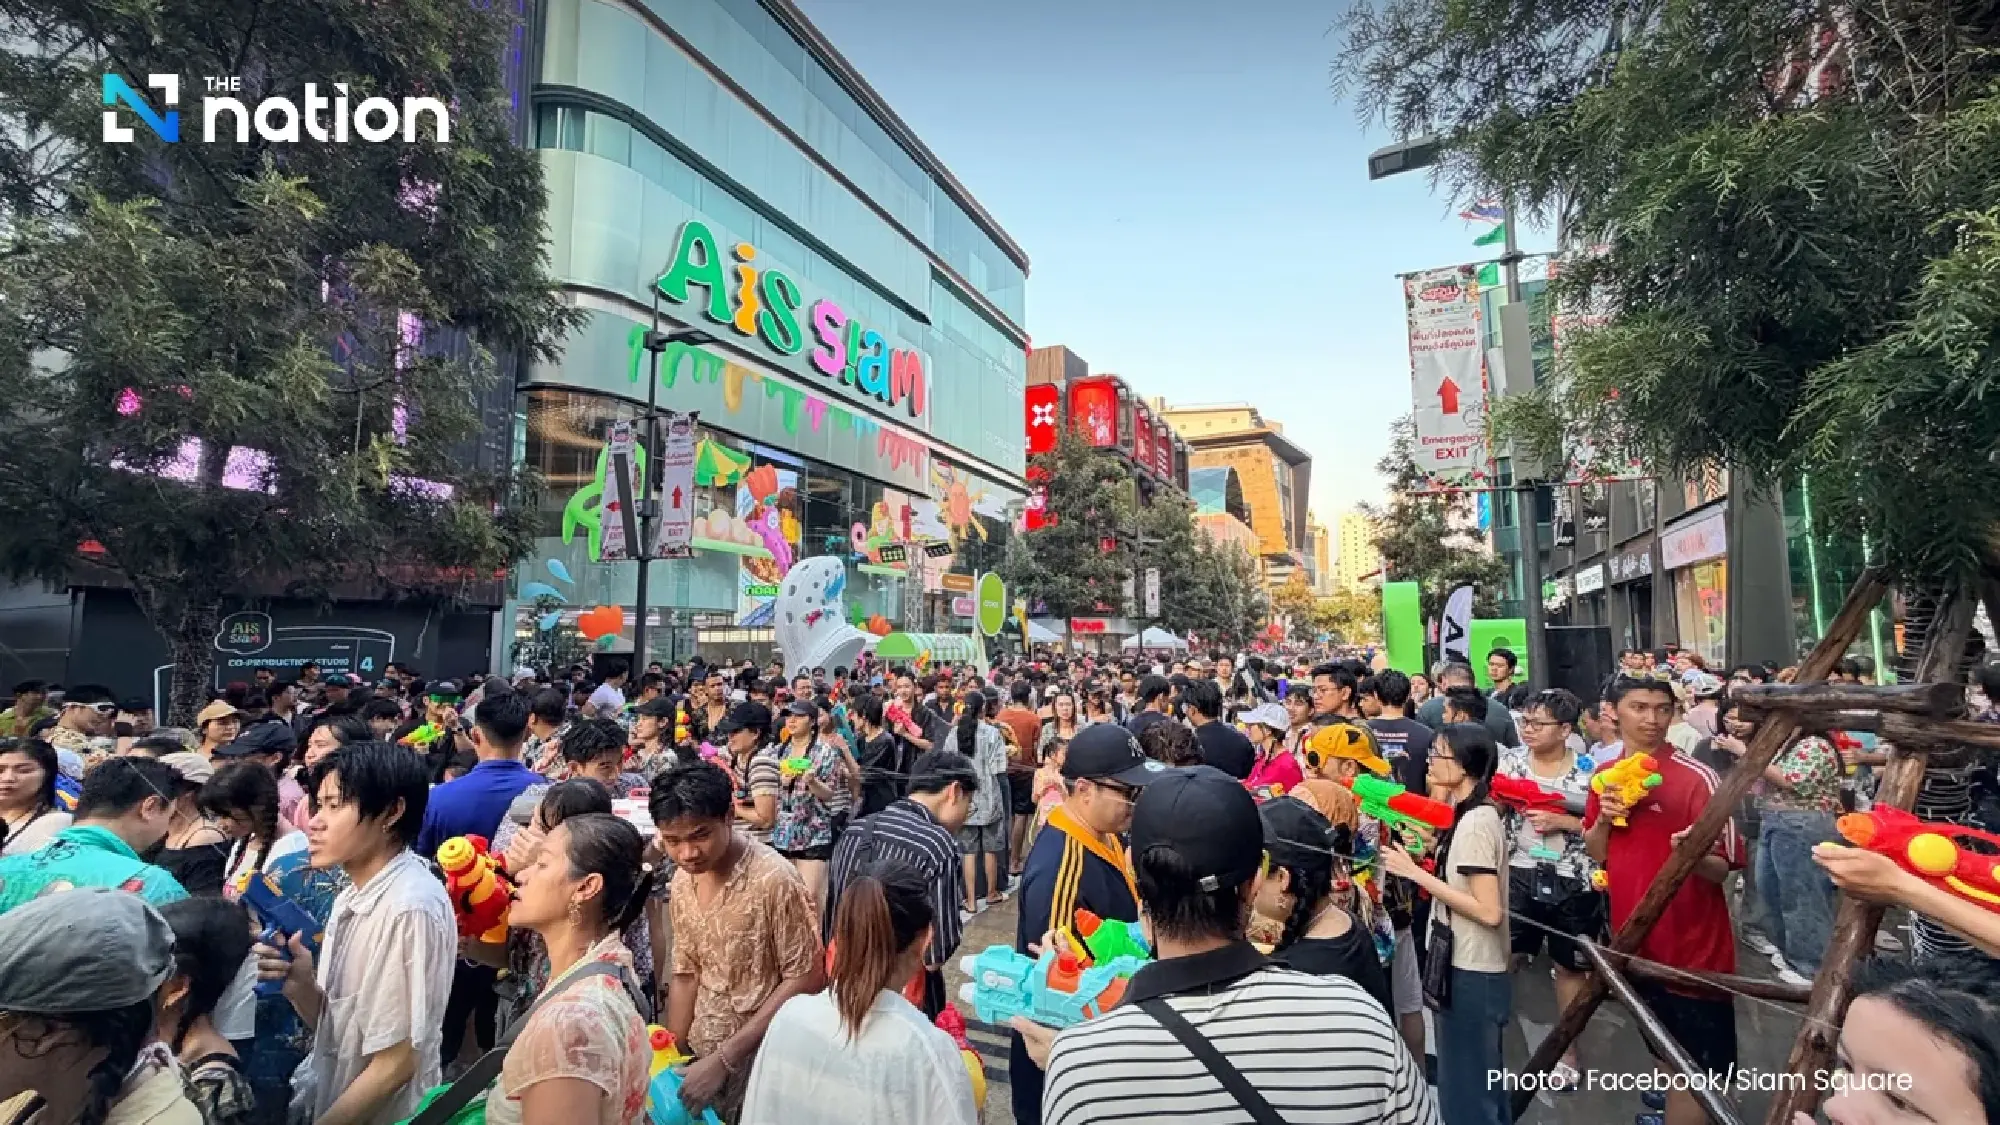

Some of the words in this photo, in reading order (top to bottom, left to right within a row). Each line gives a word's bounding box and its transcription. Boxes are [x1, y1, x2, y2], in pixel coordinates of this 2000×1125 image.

[1421, 434, 1481, 446] Emergency
[1435, 445, 1470, 460] EXIT
[359, 656, 375, 672] 4
